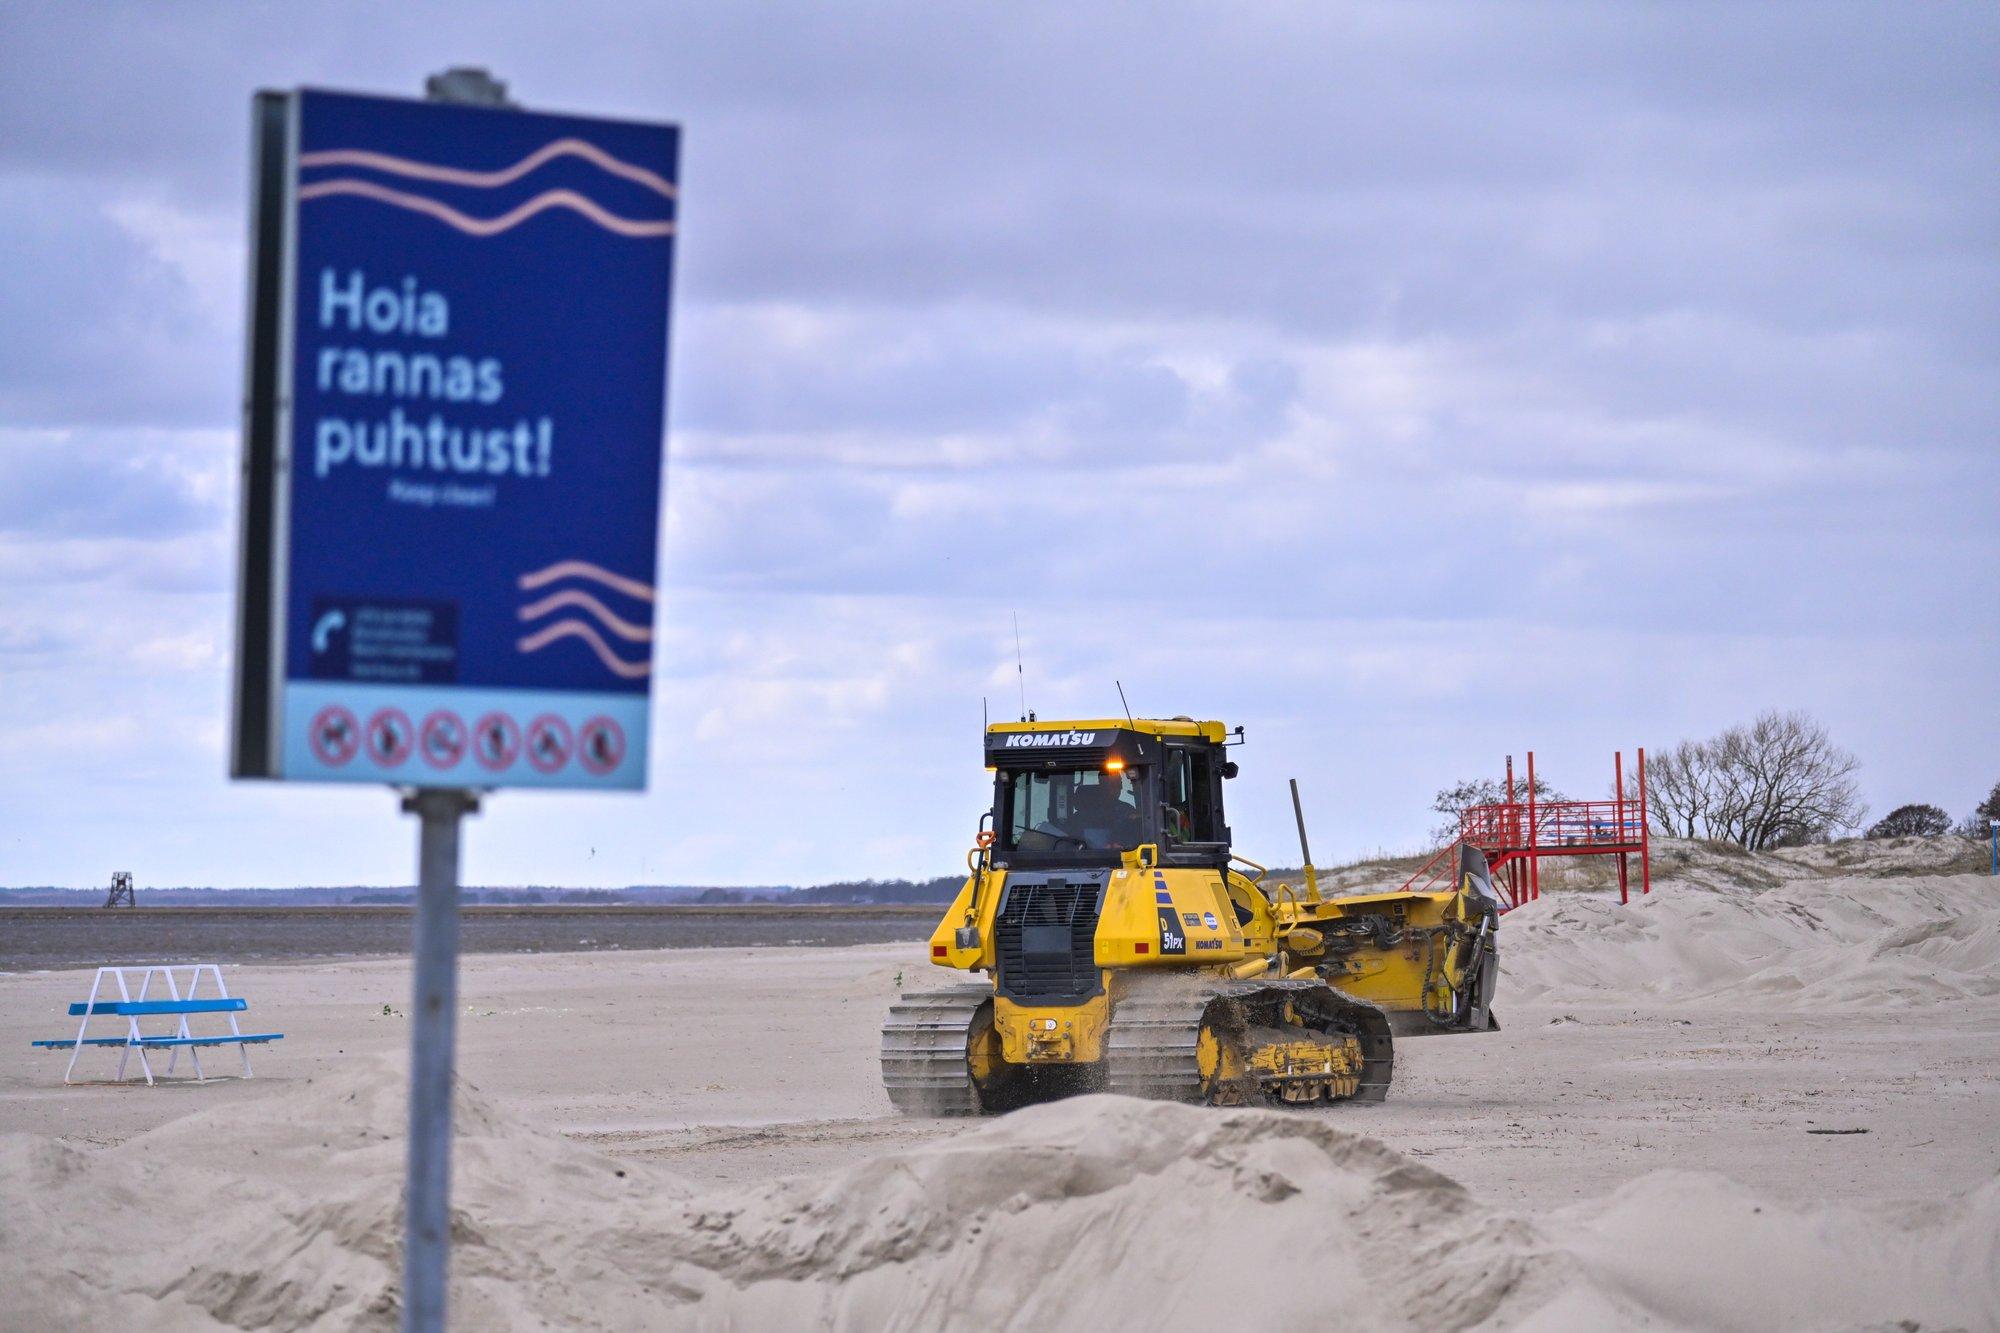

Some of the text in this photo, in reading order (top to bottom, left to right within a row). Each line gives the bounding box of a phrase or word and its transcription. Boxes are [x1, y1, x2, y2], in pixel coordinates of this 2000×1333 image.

[319, 267, 449, 338] Hoia
[317, 347, 504, 404] rannas
[314, 407, 553, 478] puhtust!
[1005, 731, 1096, 748] KOMATSU
[1195, 938, 1223, 950] KOMATSU
